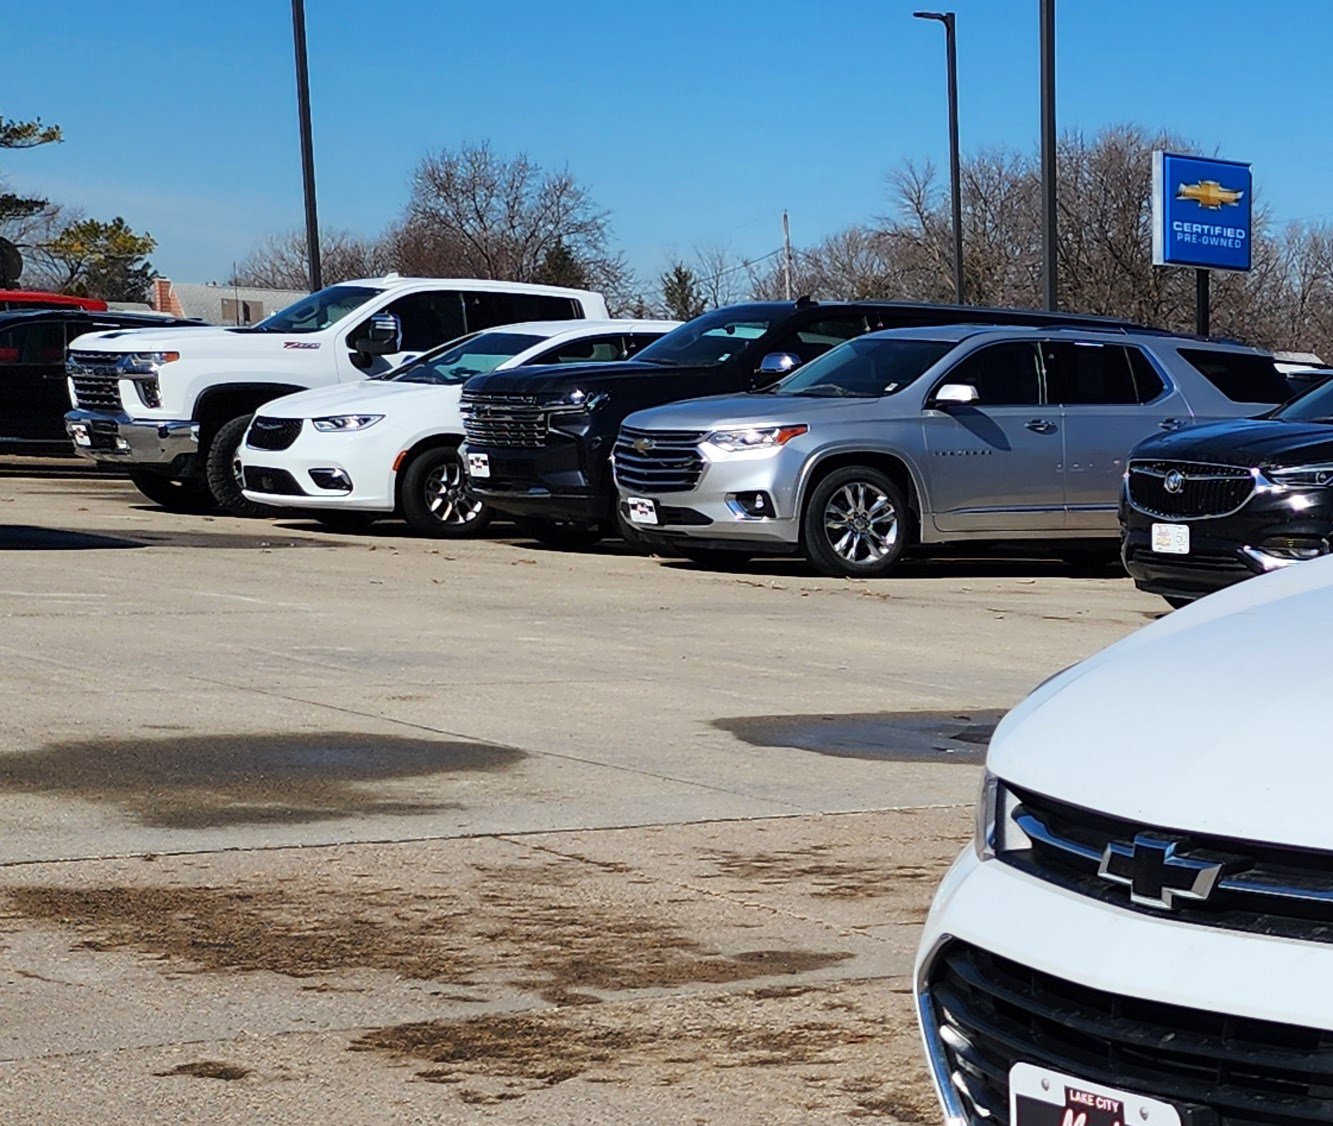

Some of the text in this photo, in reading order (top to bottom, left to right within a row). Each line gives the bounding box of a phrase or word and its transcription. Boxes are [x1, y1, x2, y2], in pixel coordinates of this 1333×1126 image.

[1173, 221, 1246, 239] CERTIFIED
[1176, 232, 1242, 248] PRE-OWNED
[1069, 1089, 1119, 1113] LAKE CITY
